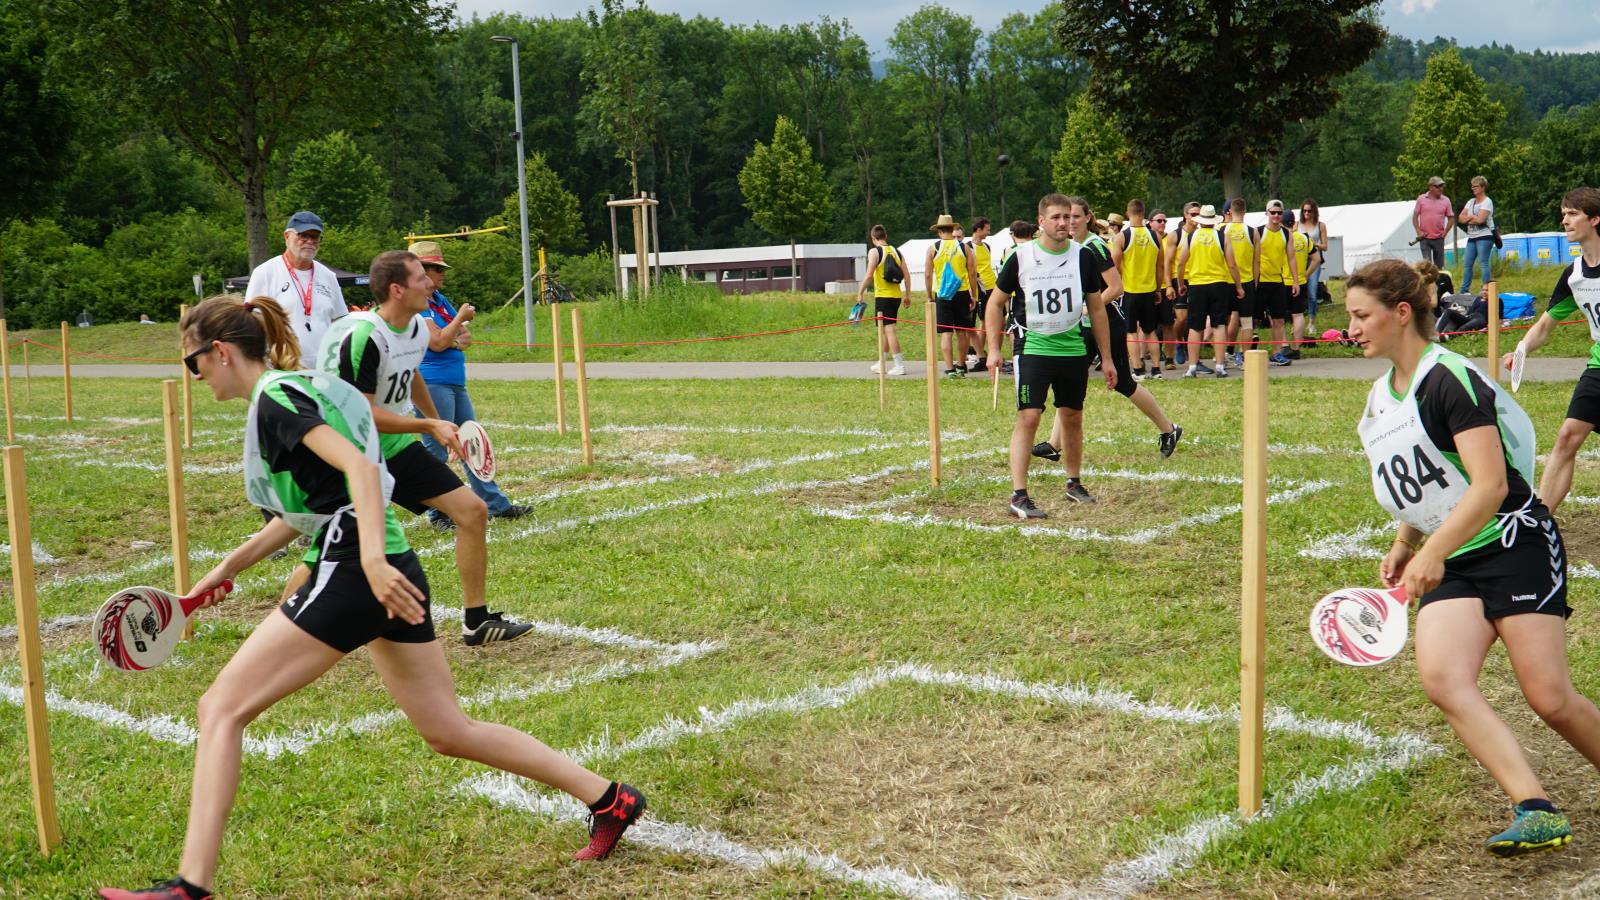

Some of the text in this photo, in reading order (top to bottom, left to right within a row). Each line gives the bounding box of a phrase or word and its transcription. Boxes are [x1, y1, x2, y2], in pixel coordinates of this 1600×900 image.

[1032, 287, 1073, 315] 181
[384, 369, 417, 404] 18
[1377, 443, 1450, 510] 184
[1511, 593, 1537, 602] hummel
